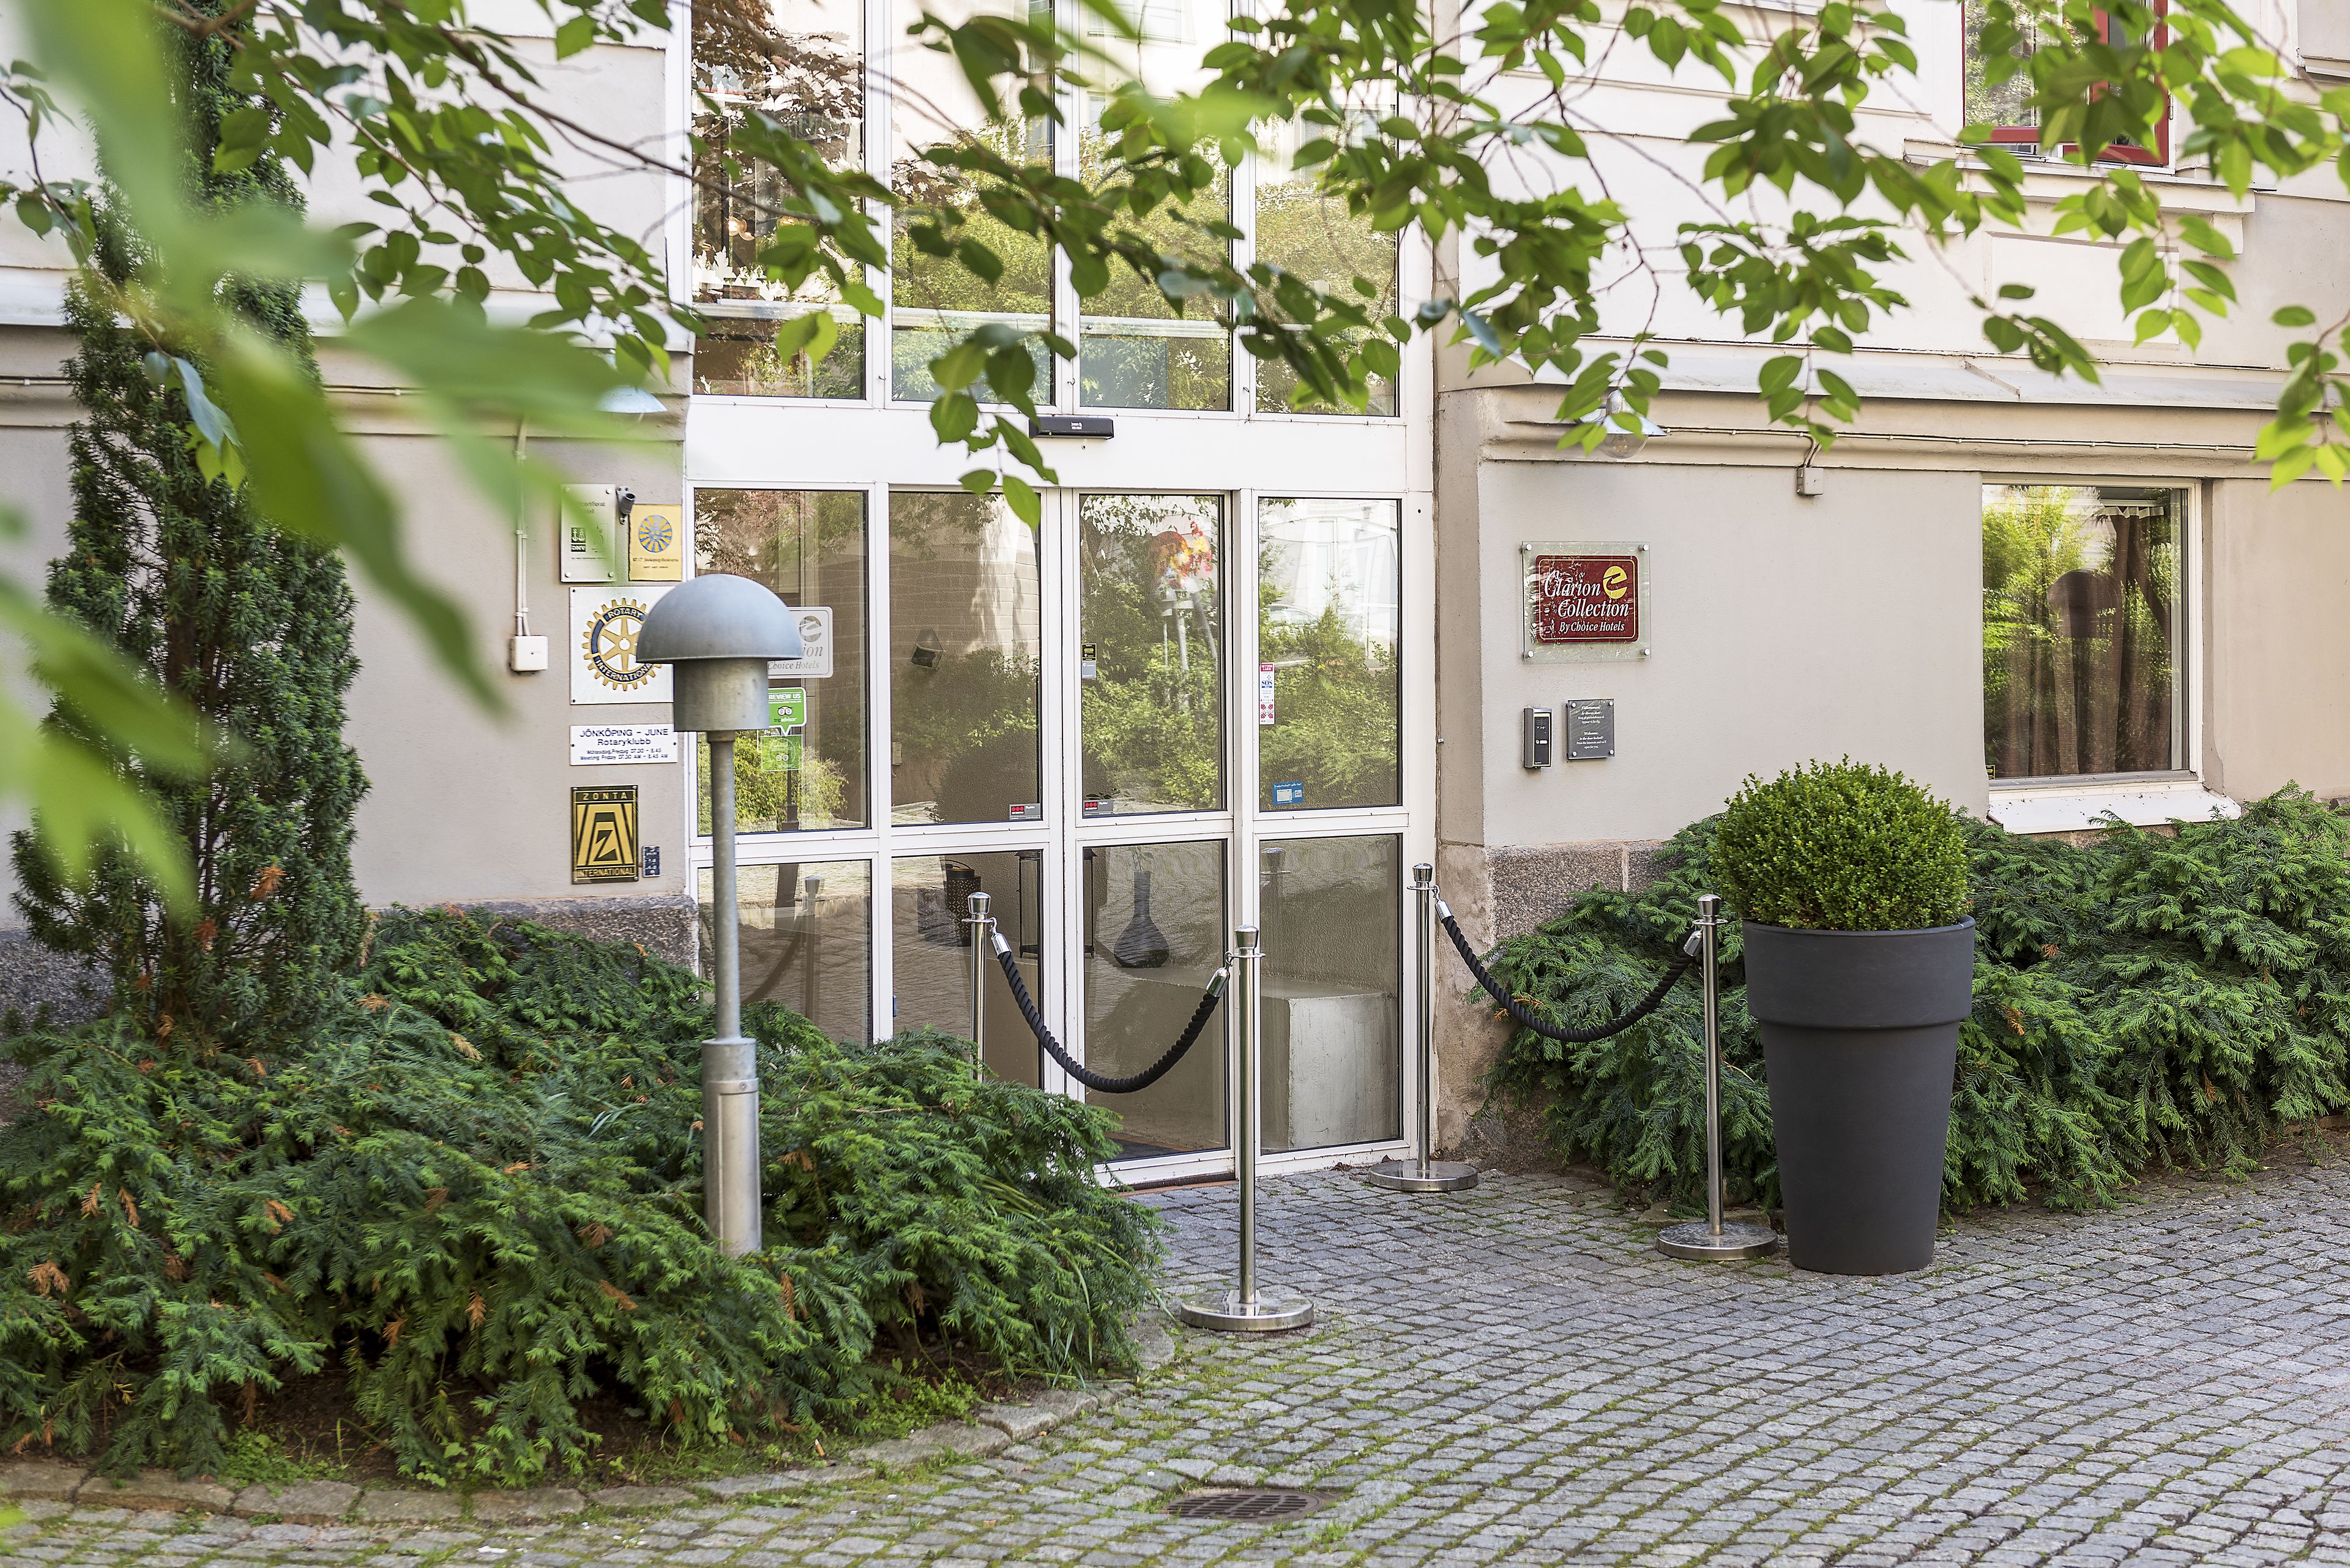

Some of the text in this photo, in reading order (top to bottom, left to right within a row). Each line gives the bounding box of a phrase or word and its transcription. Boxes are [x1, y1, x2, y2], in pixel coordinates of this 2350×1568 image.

[1544, 570, 1601, 597] Clarion
[608, 608, 643, 618] ROTARY
[1557, 598, 1629, 618] Collection
[1560, 621, 1625, 634] By Choice Hotels
[796, 660, 819, 669] Hotels
[595, 660, 652, 681] INTERNATIONA
[580, 728, 633, 737] JÖNKÖPING
[578, 868, 635, 877] INTERNATIONAL
